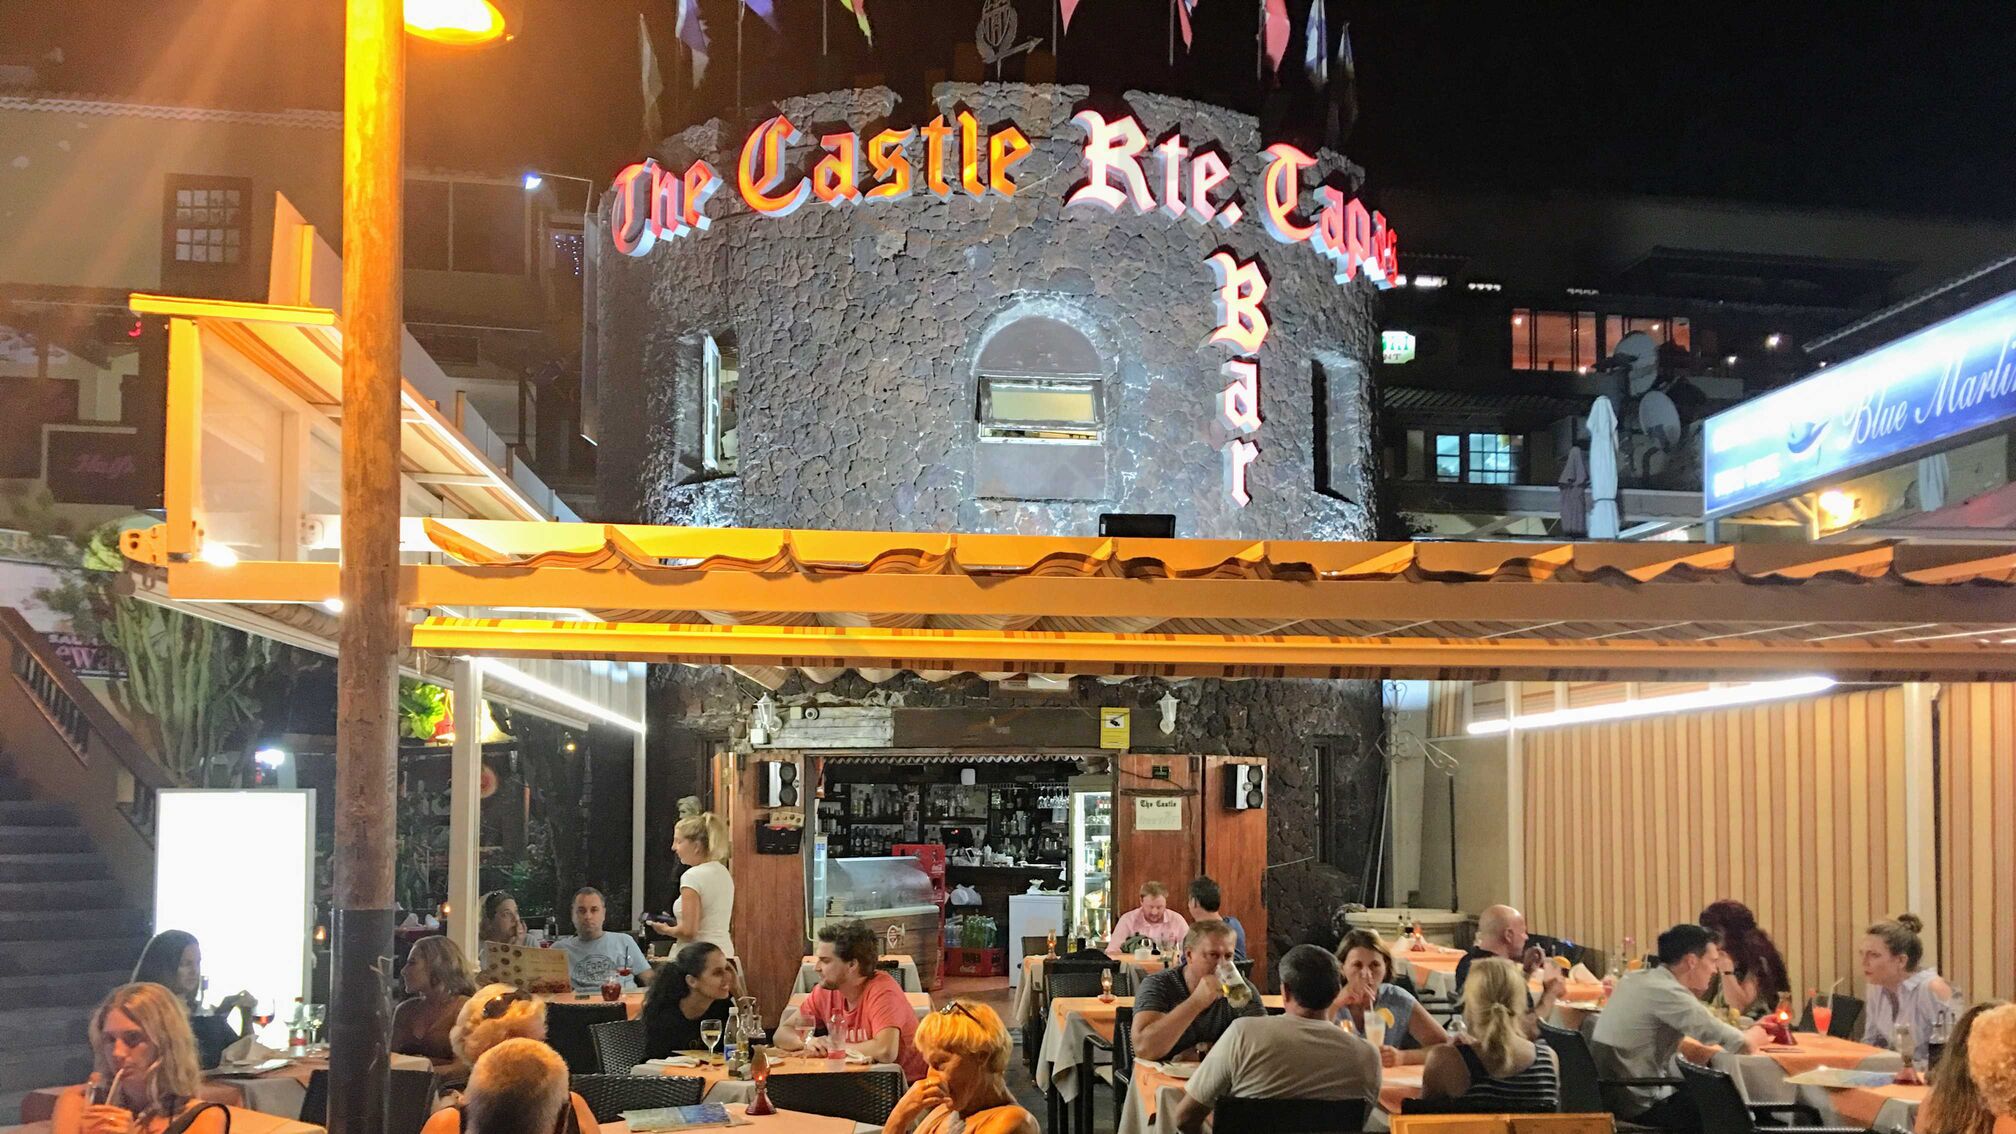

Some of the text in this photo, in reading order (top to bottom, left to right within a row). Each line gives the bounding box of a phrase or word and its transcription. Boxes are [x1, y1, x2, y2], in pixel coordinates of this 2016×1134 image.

[612, 110, 1398, 290] The Castle Rte. Tapas
[1204, 252, 1269, 508] Bar
[1842, 332, 2016, 447] Blue Marli
